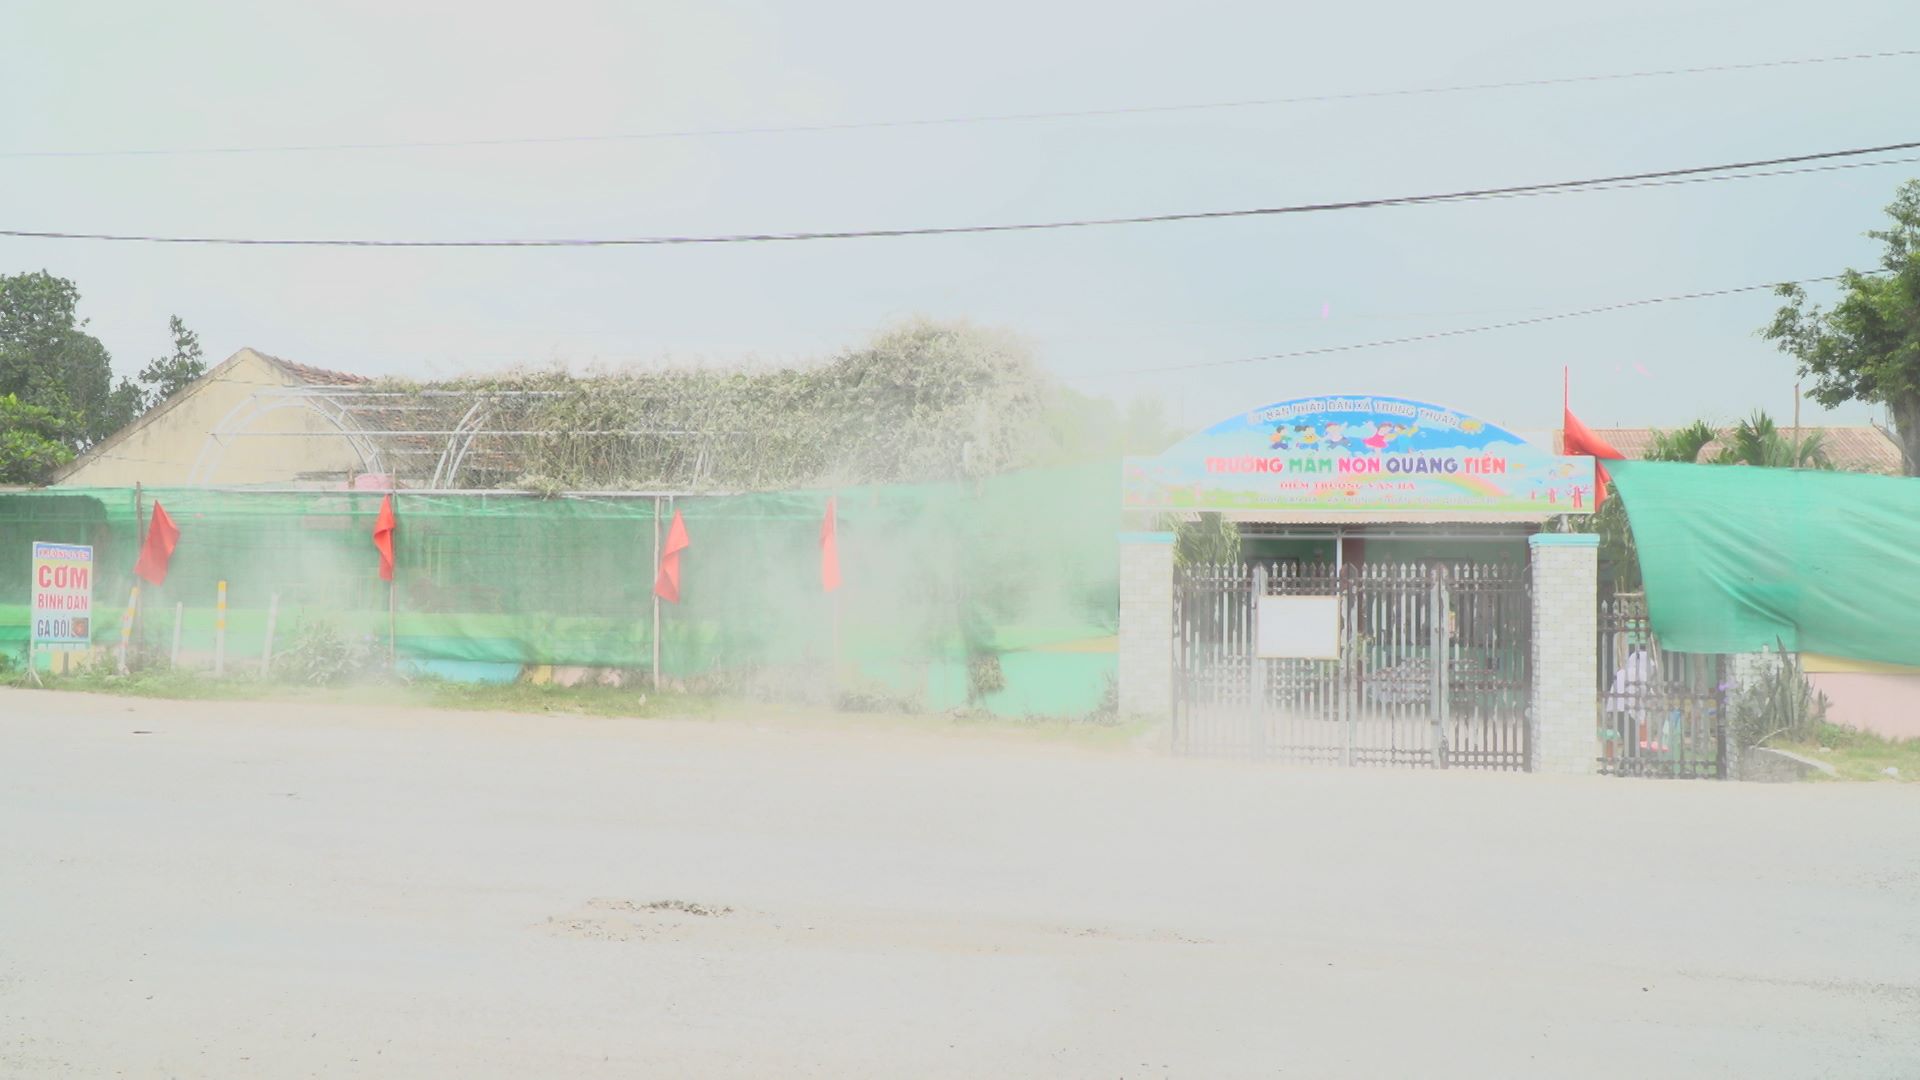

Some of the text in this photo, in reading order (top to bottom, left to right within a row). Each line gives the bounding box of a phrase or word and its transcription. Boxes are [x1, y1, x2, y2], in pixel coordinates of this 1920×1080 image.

[1338, 457, 1381, 474] NON
[1386, 452, 1458, 474] QUẢNG
[38, 565, 88, 590] CƠM
